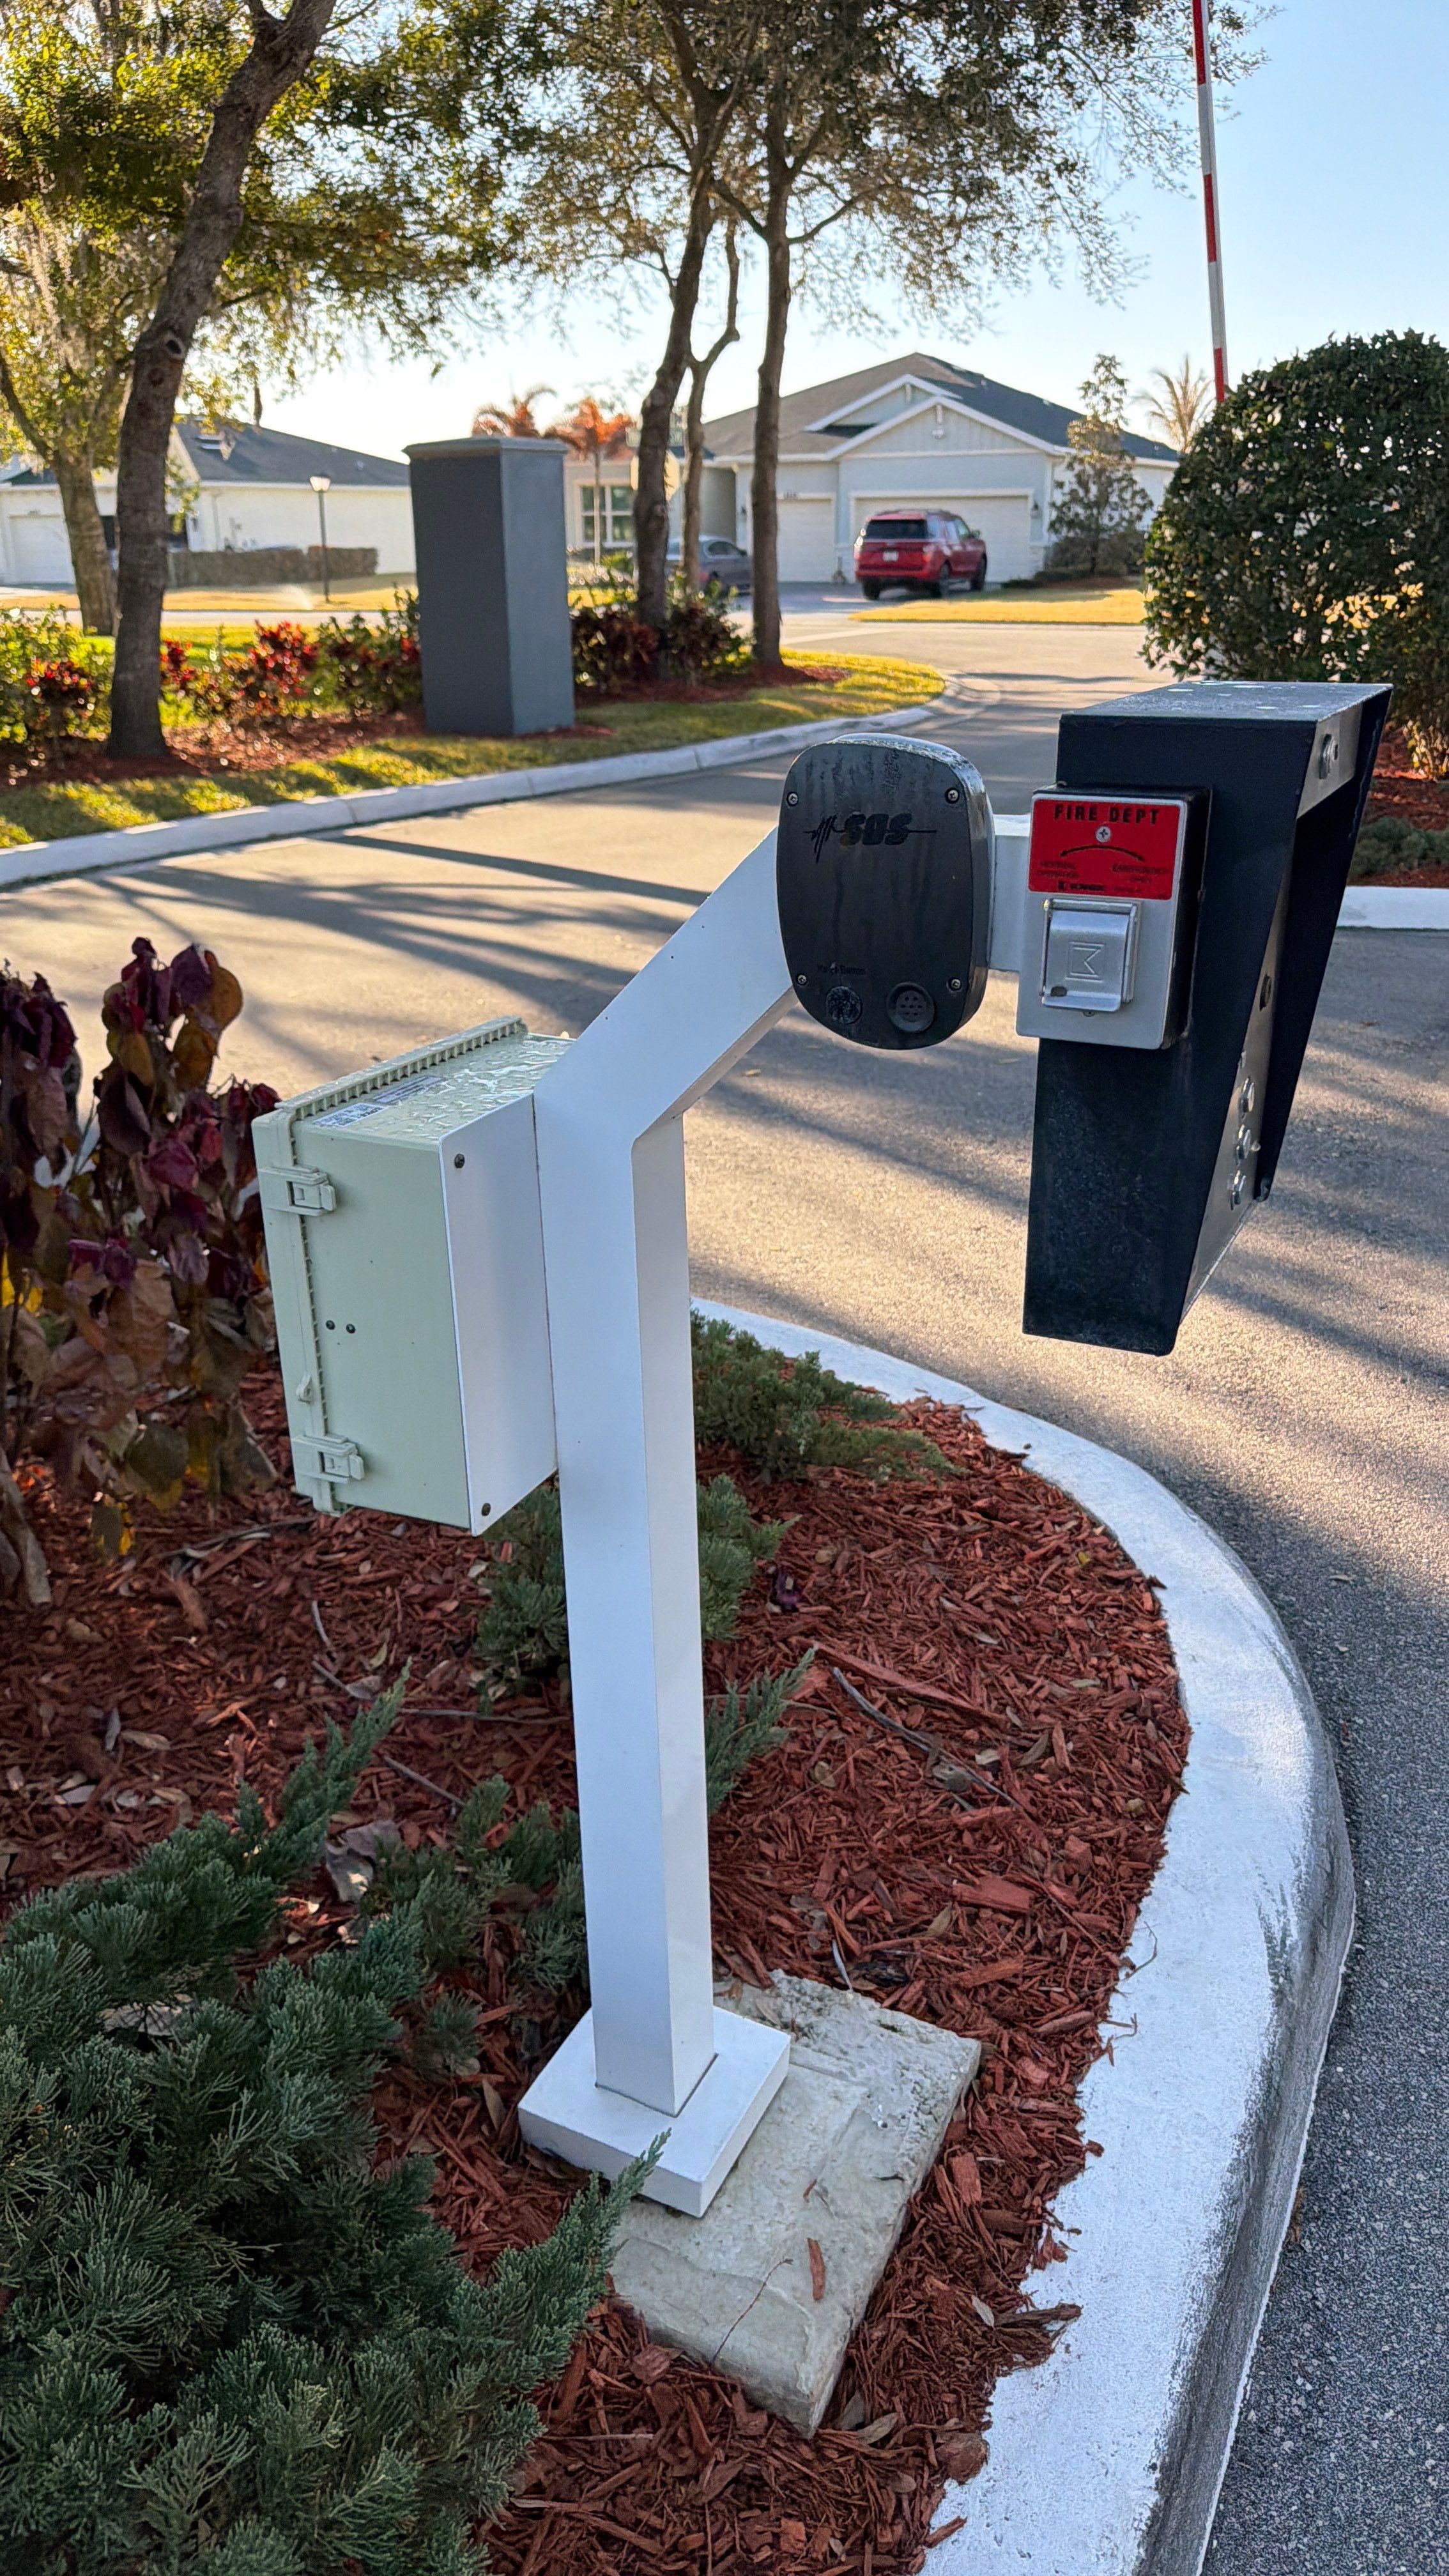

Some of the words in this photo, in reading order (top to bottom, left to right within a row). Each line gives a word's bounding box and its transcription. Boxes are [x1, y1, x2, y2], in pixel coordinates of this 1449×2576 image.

[1054, 804, 1098, 821] FIRE
[1109, 807, 1160, 824] DEPT
[840, 812, 912, 846] SOS
